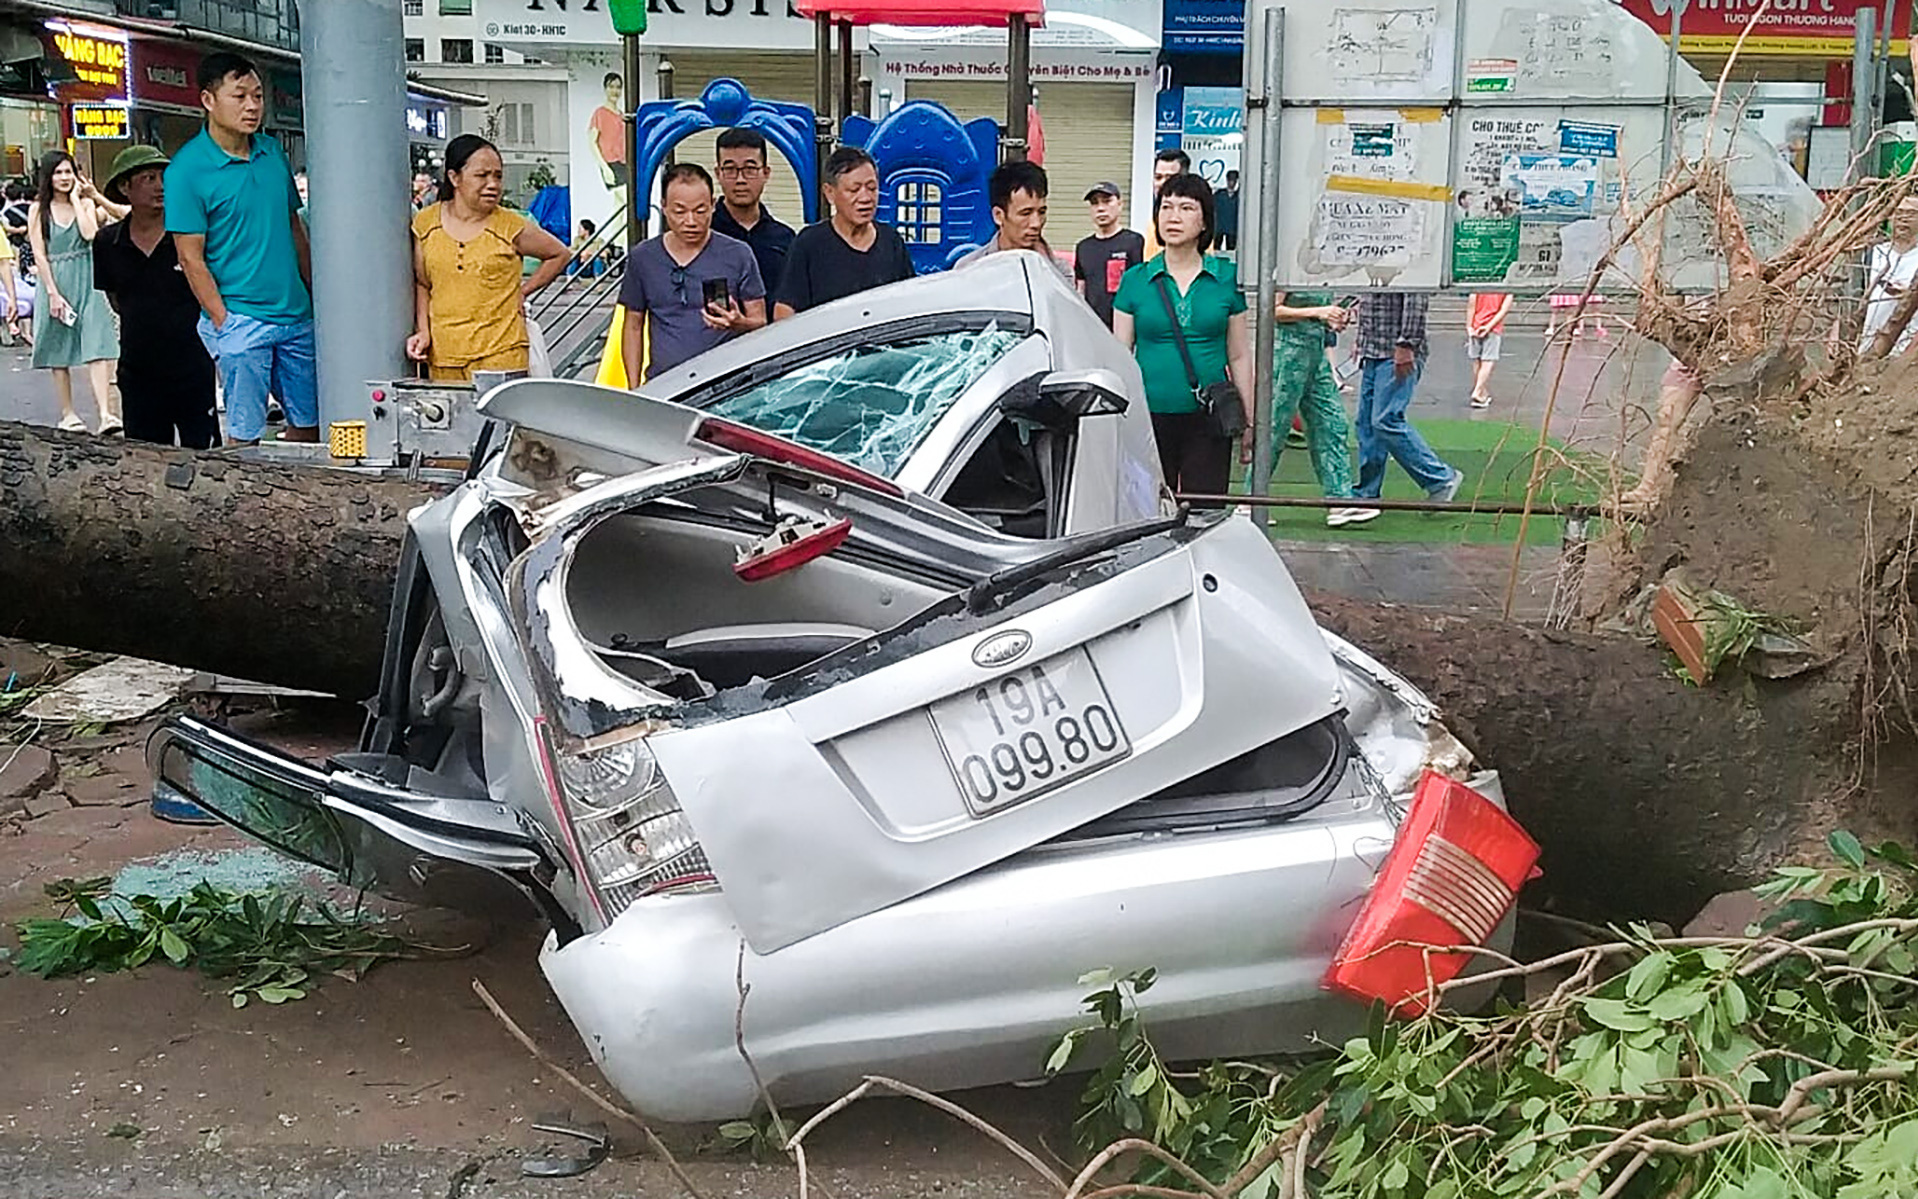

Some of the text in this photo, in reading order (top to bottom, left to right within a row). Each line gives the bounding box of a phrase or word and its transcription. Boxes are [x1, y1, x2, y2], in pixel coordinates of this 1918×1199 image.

[886, 62, 901, 75] Hệ
[904, 60, 940, 76] Thống
[942, 61, 964, 74] Nhà
[967, 60, 1001, 74] Thuốc
[1004, 63, 1049, 76] Cyên
[1077, 66, 1102, 76] Cho
[1472, 120, 1494, 132] CHO
[975, 665, 1066, 736] 19A
[962, 705, 1118, 802] 099.80
